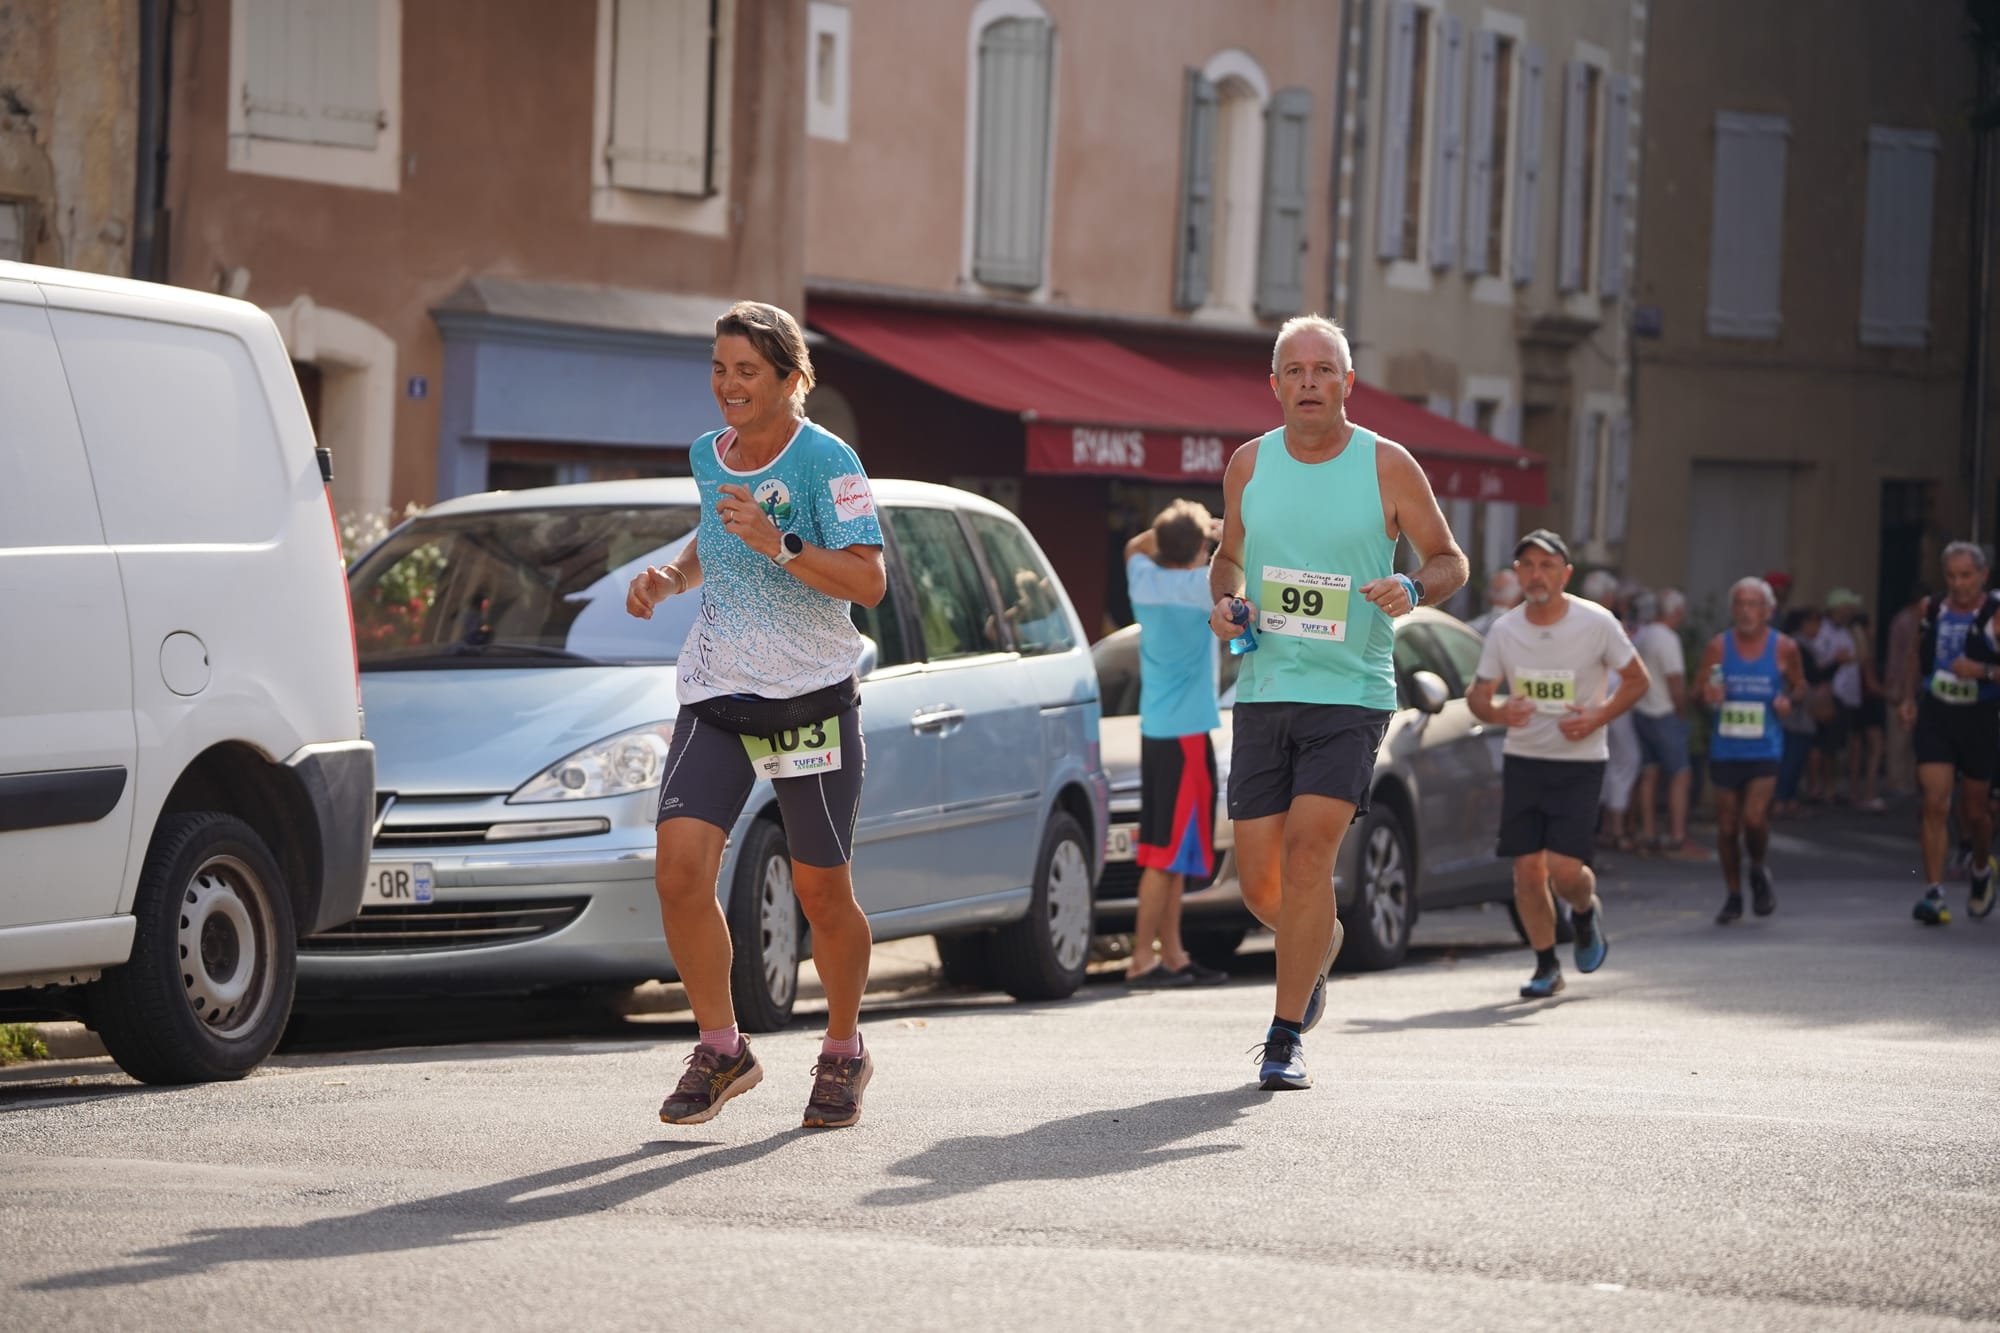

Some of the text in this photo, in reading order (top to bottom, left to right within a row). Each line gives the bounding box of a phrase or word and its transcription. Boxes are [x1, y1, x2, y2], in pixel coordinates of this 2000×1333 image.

[1073, 427, 1224, 473] RYAN'S BAR
[761, 482, 775, 492] TAC
[1281, 587, 1323, 616] 99
[1301, 622, 1329, 632] TUFF'S
[1523, 681, 1565, 699] 188
[792, 756, 824, 767] TUFF'S
